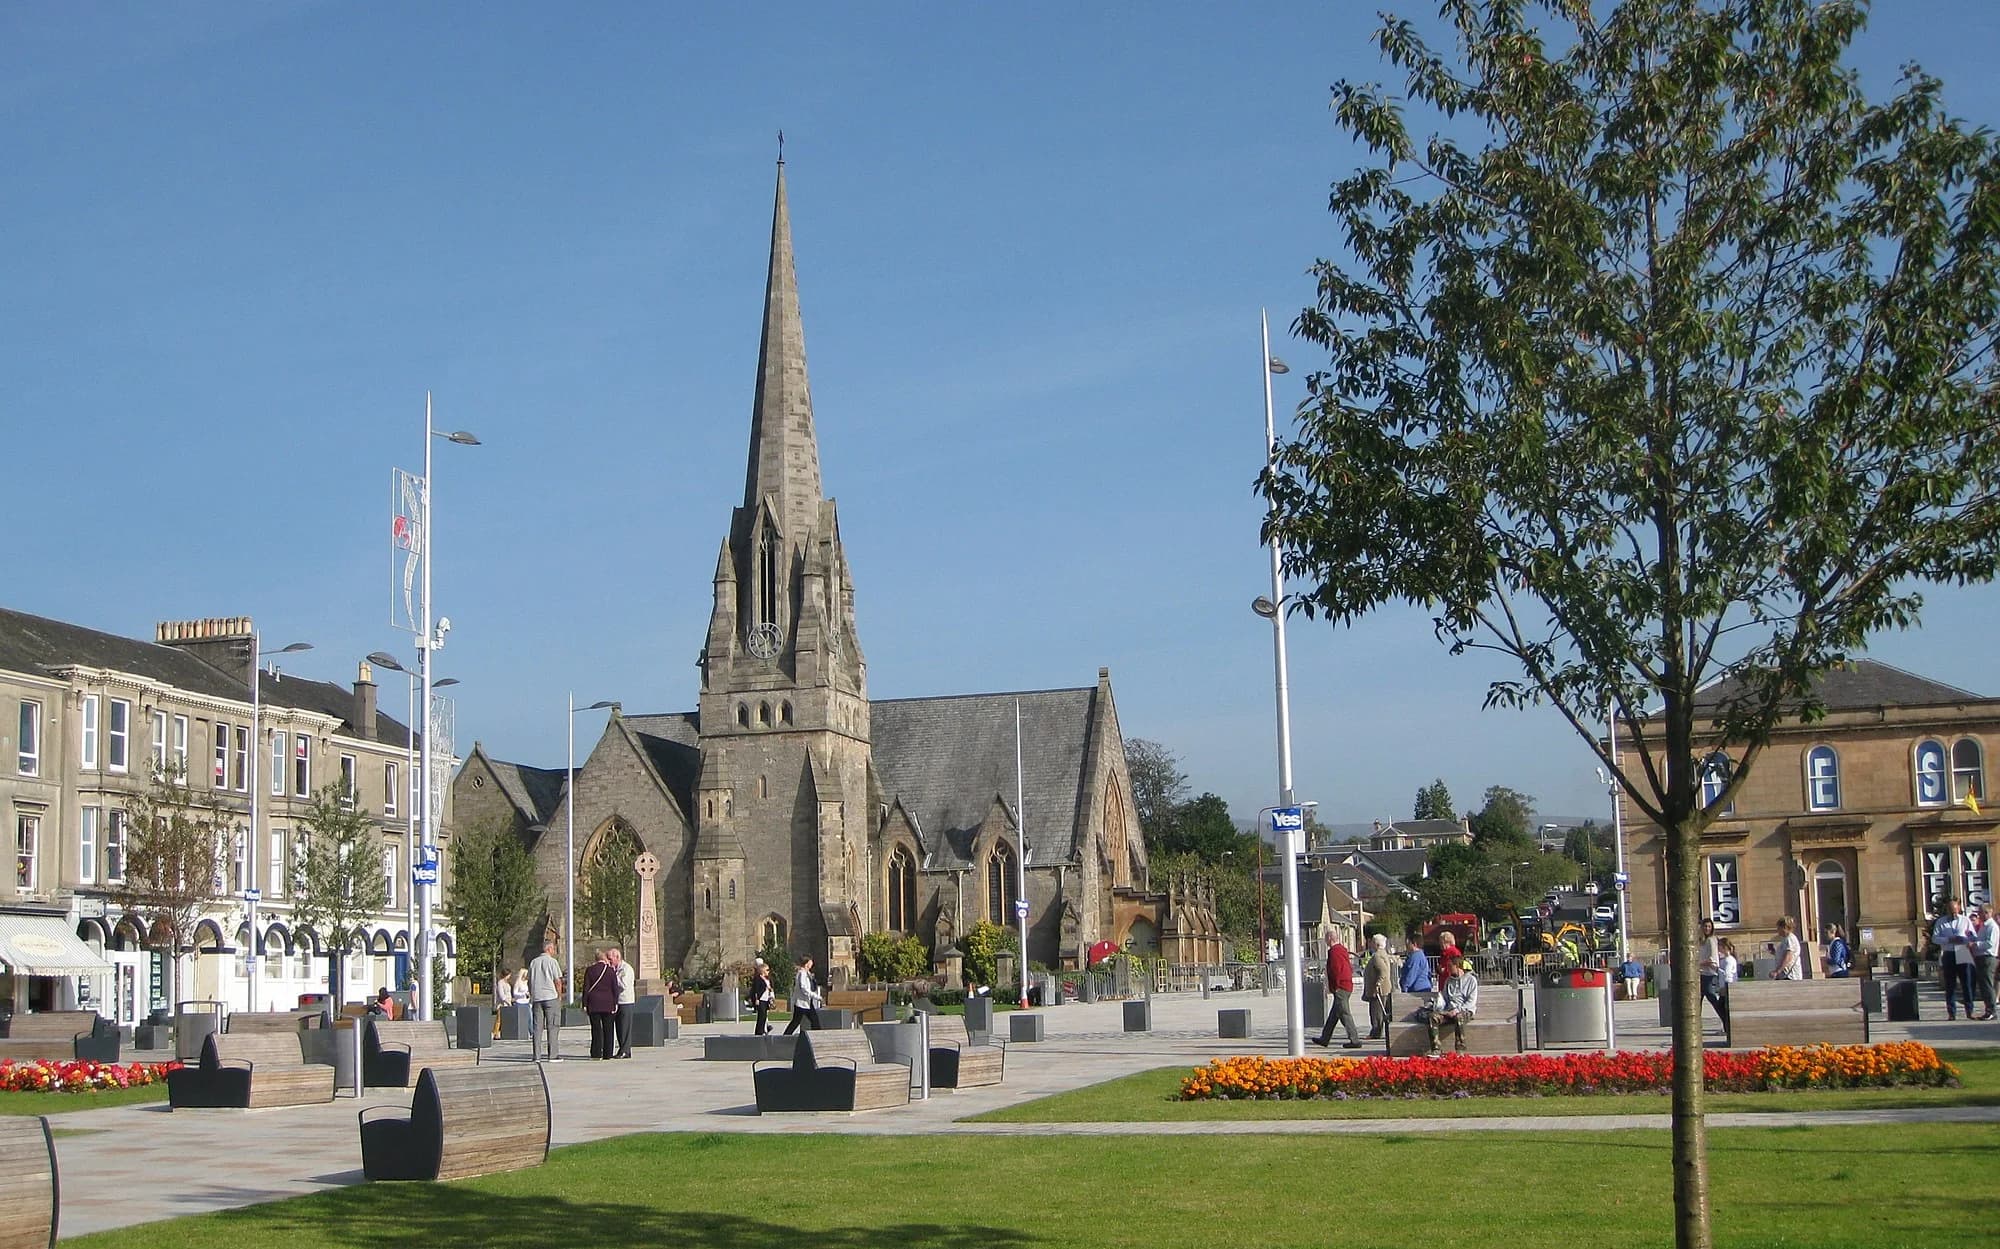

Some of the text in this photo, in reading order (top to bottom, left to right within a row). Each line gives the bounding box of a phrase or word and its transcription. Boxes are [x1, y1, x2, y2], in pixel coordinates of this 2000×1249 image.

[1272, 812, 1300, 826] Yes
[413, 867, 436, 880] Yes
[245, 890, 260, 899] Yes
[1714, 862, 1734, 922] YES
